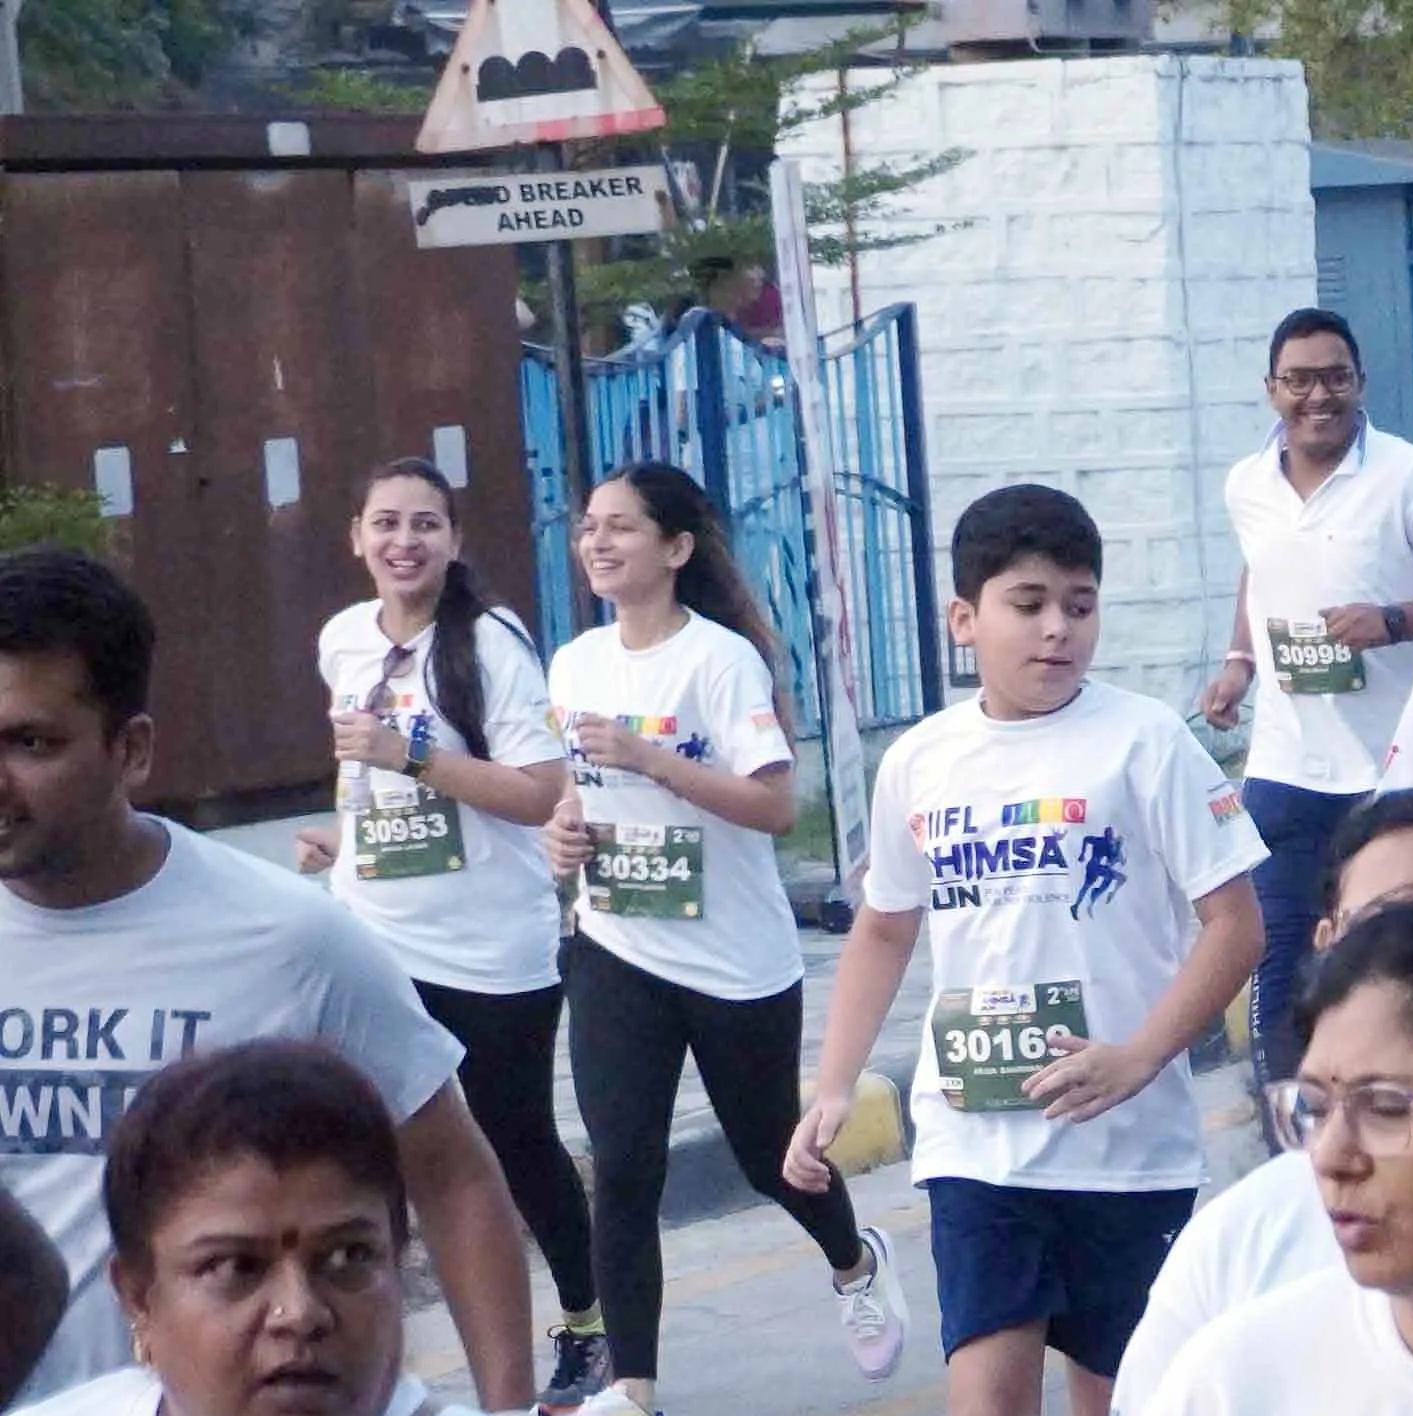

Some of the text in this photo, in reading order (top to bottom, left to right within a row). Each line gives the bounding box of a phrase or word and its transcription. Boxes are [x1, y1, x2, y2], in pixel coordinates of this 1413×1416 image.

[520, 177, 643, 202] BREAKER
[497, 208, 584, 232] AHEAD
[361, 813, 448, 844] 30953
[928, 800, 1086, 839] IIFL JIO
[598, 854, 691, 881] 30334
[927, 832, 1069, 879] HIMSA
[932, 884, 981, 910] UN
[0, 1008, 211, 1062] ORK IT
[0, 1085, 101, 1140] WN
